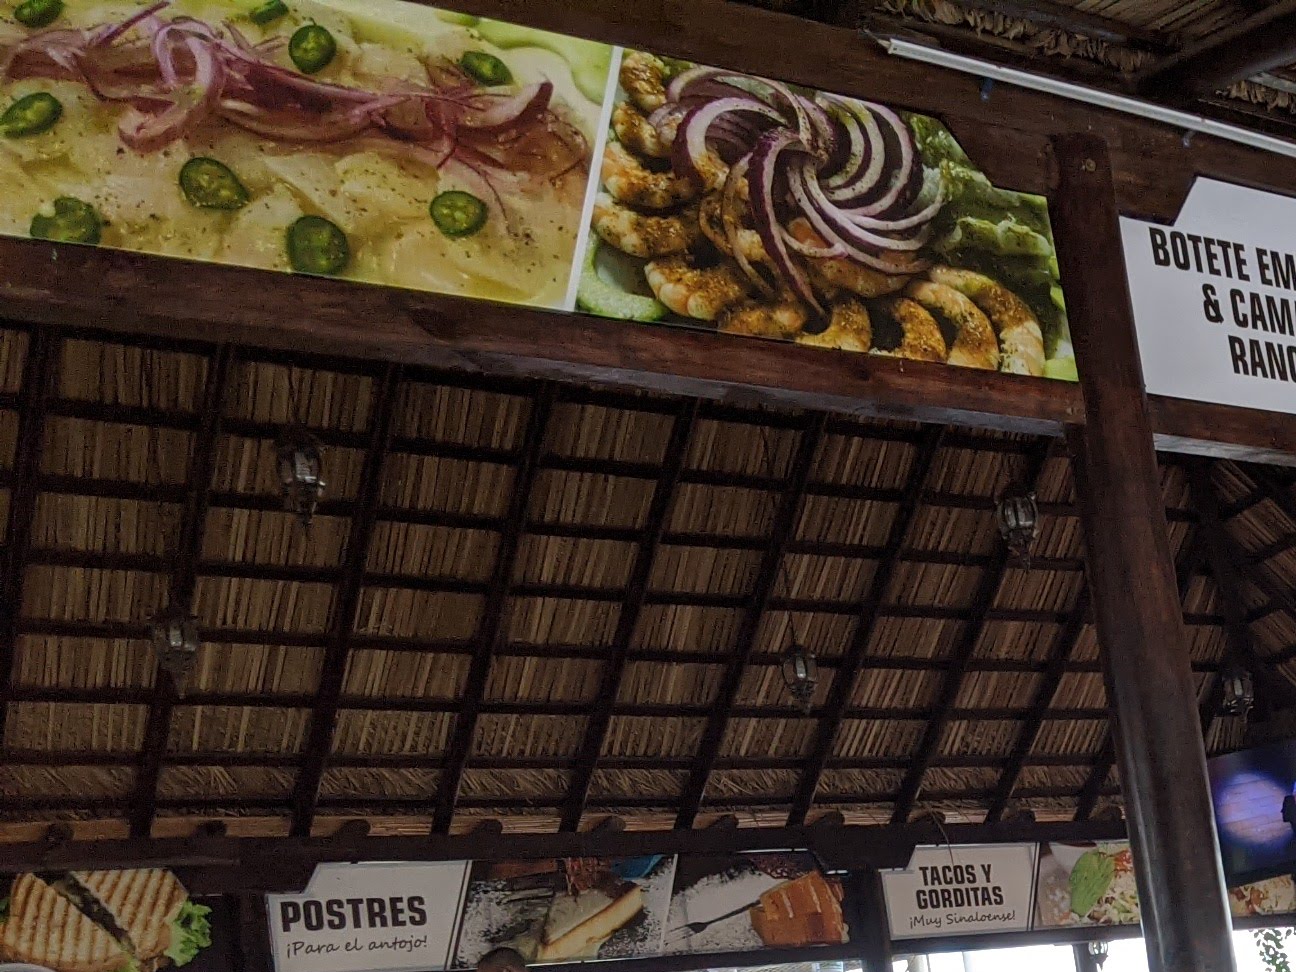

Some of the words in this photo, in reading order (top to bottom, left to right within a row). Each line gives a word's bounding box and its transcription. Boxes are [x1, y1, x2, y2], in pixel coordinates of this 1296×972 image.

[1149, 226, 1250, 281] BOTETE
[1201, 283, 1224, 324] &
[919, 864, 977, 886] TACOS
[979, 863, 992, 883] Y
[915, 886, 1004, 910] GORDITAS
[280, 896, 427, 932] POSTRES
[909, 915, 942, 930] ¡Muy
[946, 910, 1016, 925] Sinaloense!
[286, 941, 341, 959] ¡Para
[344, 938, 364, 951] el
[368, 935, 428, 953] antojo!
